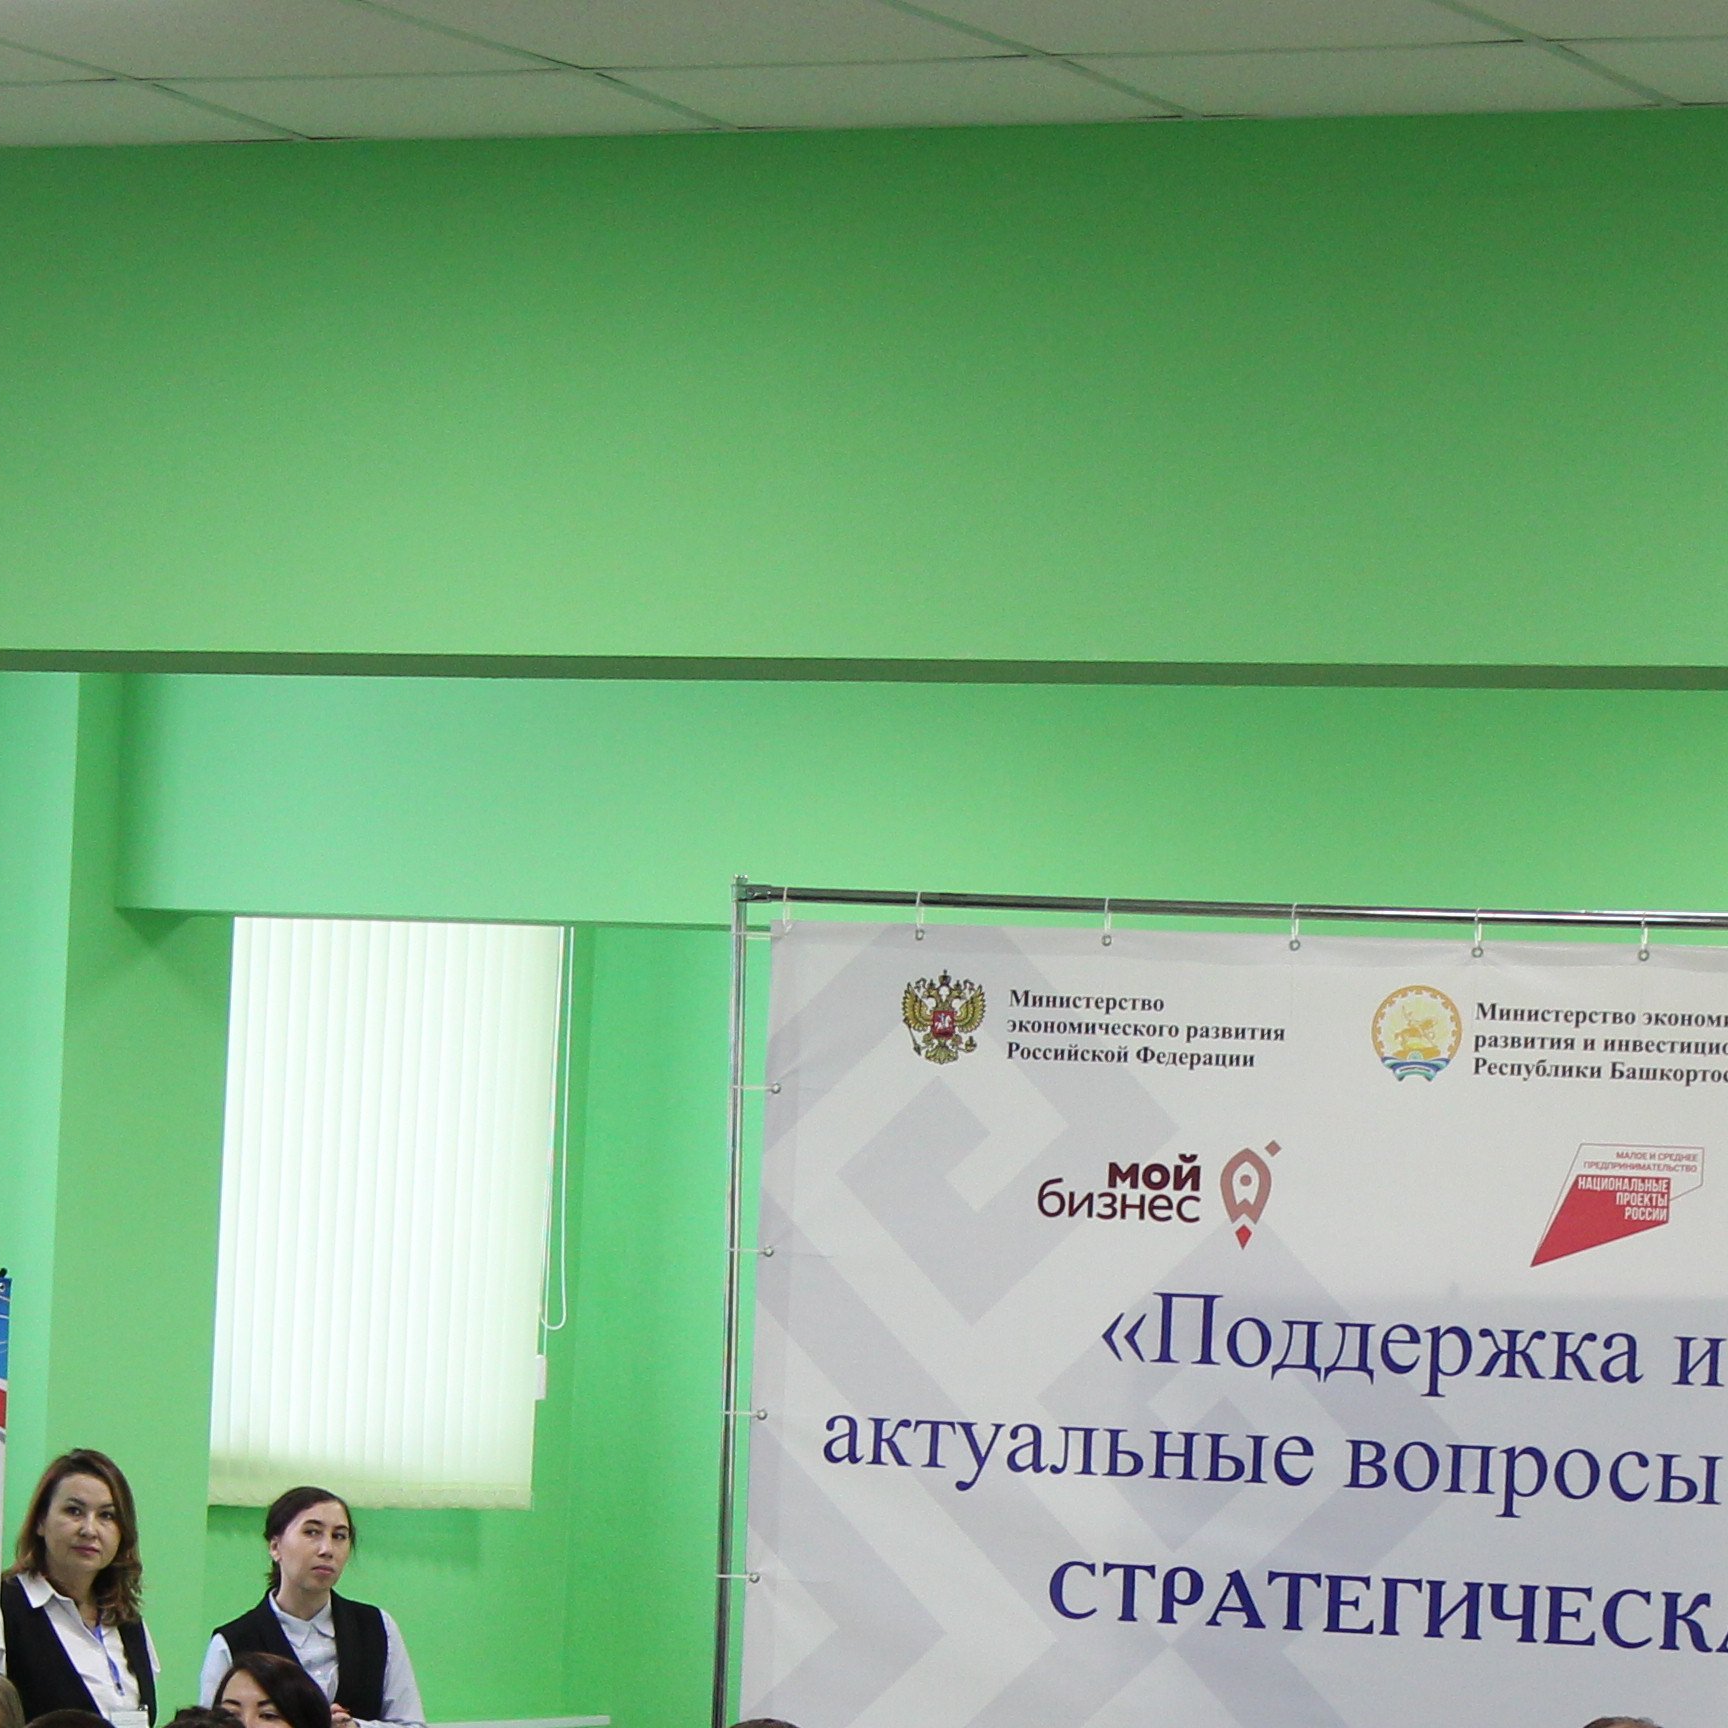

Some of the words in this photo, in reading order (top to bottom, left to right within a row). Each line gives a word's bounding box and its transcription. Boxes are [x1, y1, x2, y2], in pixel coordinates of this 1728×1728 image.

[1009, 989, 1164, 1013] Министерство
[1475, 1001, 1636, 1027] Министерство
[1007, 1016, 1180, 1039] экономического
[1186, 1025, 1286, 1044] развития
[1007, 1042, 1129, 1064] Российской
[1136, 1045, 1255, 1070] Федерации
[1473, 1034, 1575, 1054] развития
[1583, 1040, 1596, 1051] и
[1472, 1057, 1602, 1082] Республики
[1583, 1161, 1697, 1173] ПРЕДПРИНИМАТЕЛЬСТВО
[1616, 1152, 1648, 1160] МАЛОЕ
[1658, 1153, 1698, 1162] СРЕДНЕЕ
[1107, 1153, 1201, 1192] мой
[1578, 1176, 1668, 1193] НАЦИОНАЛЬНЫЕ
[1038, 1178, 1200, 1223] бизнес
[1616, 1192, 1668, 1207] ПРОЕКТЫ
[1624, 1207, 1667, 1221] РОССИИ
[1101, 1291, 1644, 1397] «Поддержка
[1673, 1334, 1725, 1388] и
[823, 1412, 1315, 1491] актуальные
[1345, 1436, 1722, 1518] вопросы
